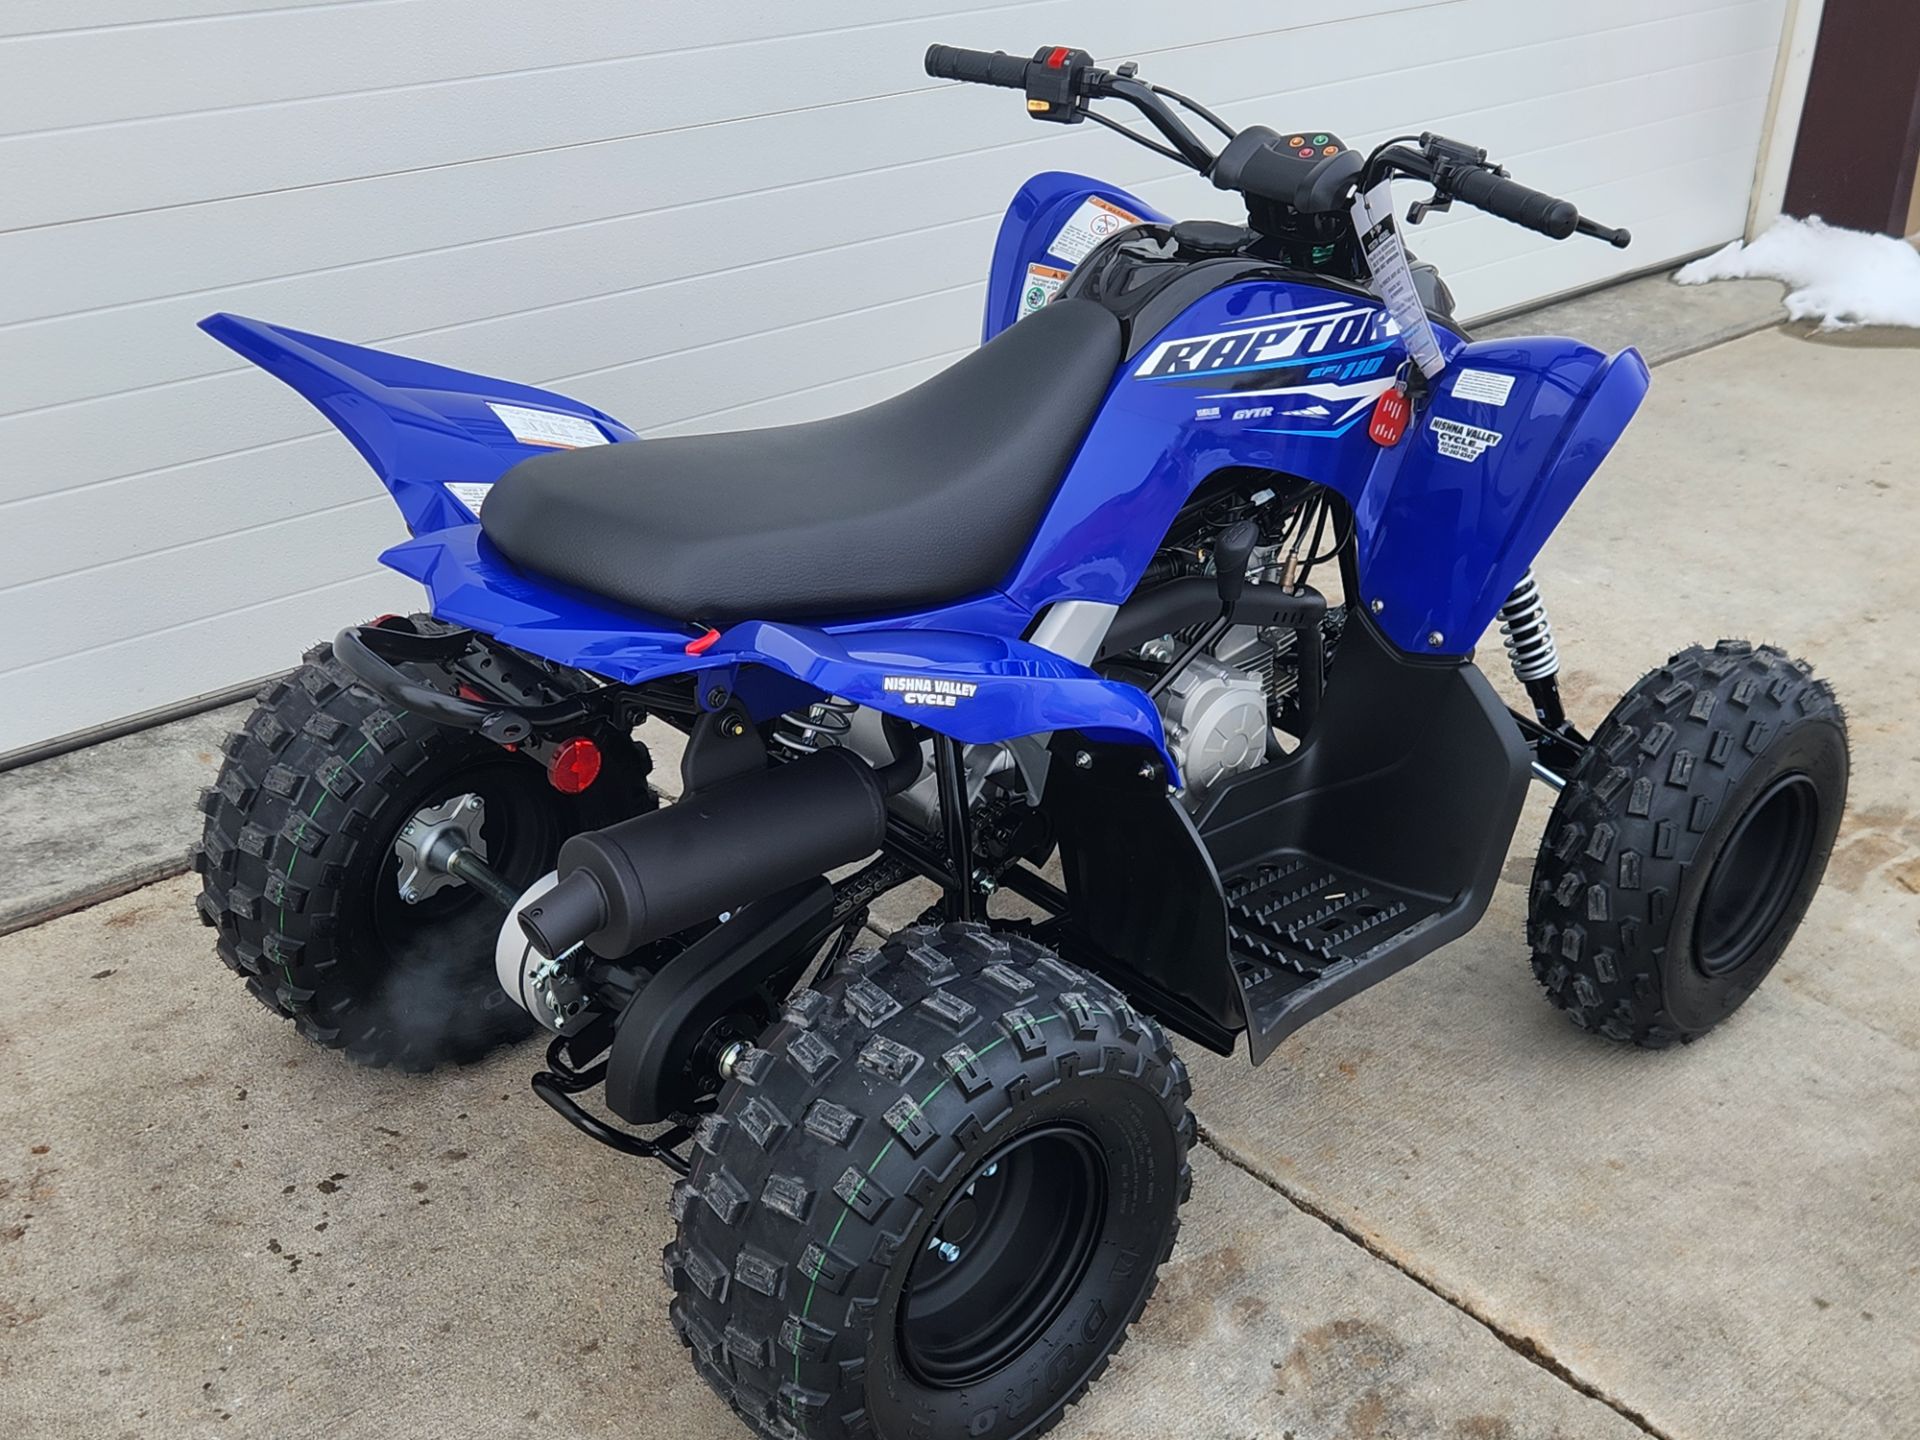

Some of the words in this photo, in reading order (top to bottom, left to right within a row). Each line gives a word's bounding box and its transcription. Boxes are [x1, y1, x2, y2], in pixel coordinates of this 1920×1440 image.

[1154, 308, 1399, 375] RAPTOR
[1339, 355, 1386, 380] 110
[1232, 406, 1274, 421] GYTR
[1432, 419, 1465, 436] NISHNA
[1466, 427, 1500, 444] VALLEY
[1439, 432, 1477, 447] CYCLE
[884, 677, 932, 692] NISHNA
[934, 680, 977, 697] VALLEY
[904, 693, 957, 707] CYCLE
